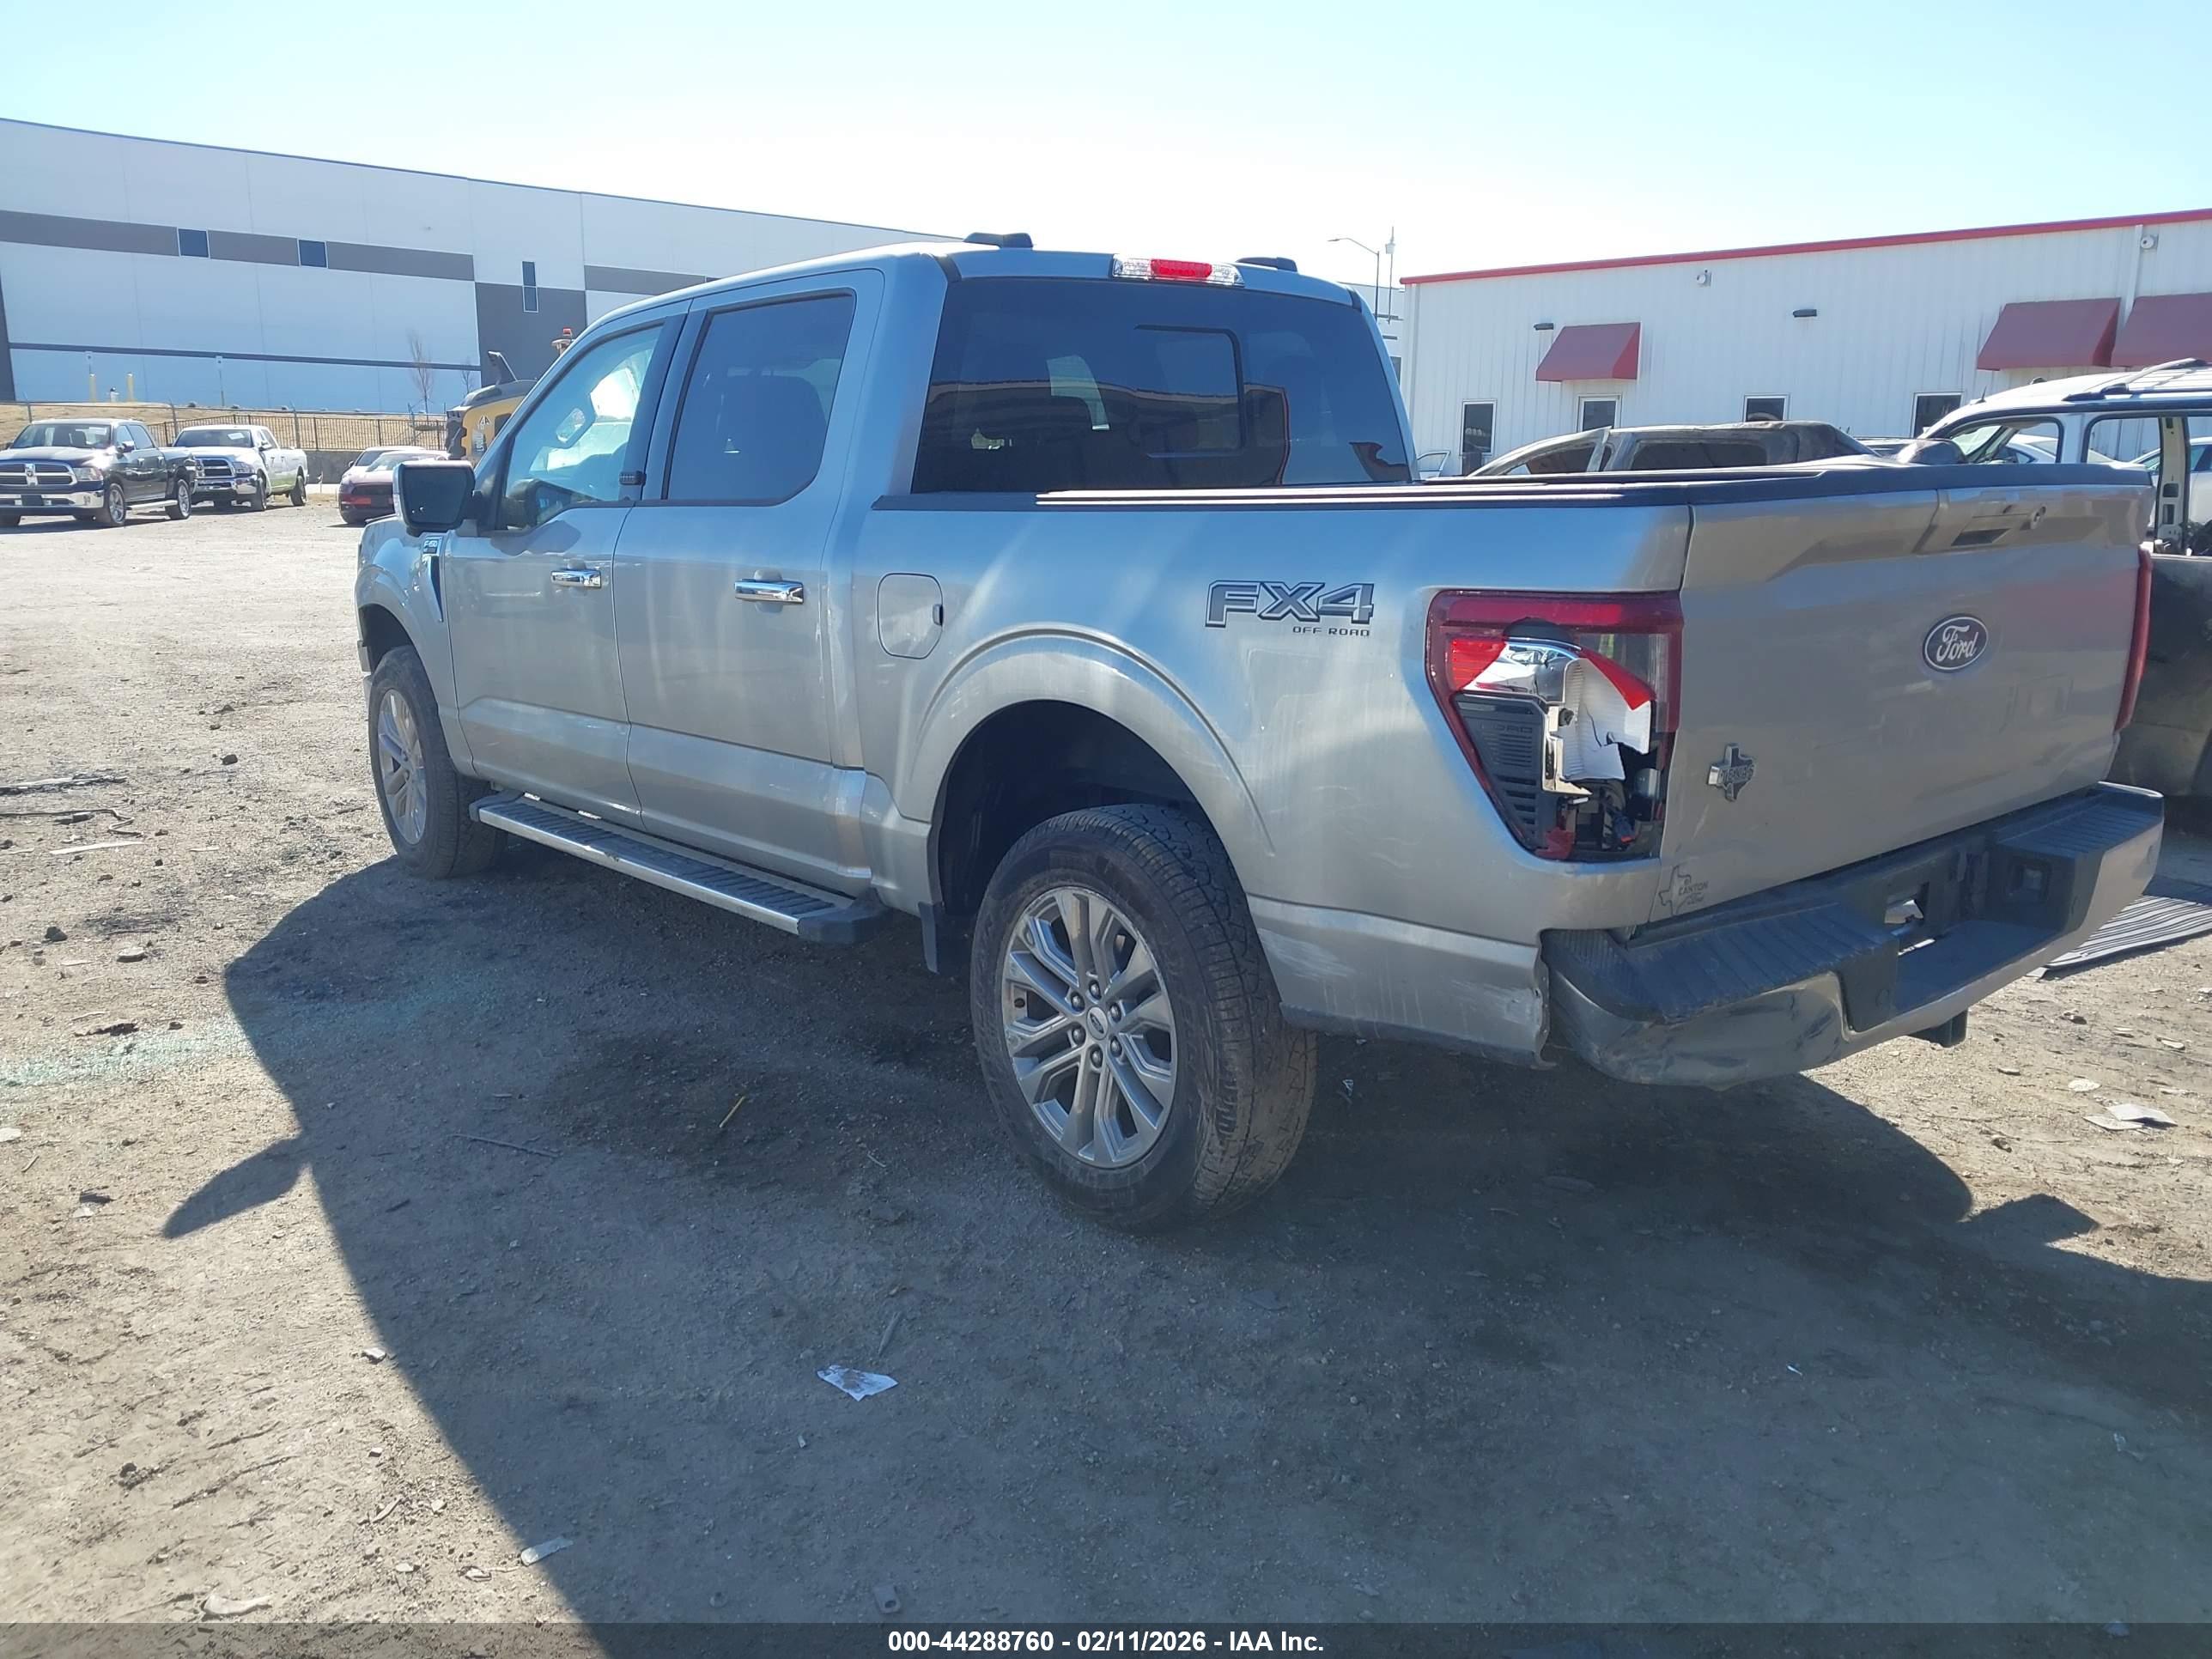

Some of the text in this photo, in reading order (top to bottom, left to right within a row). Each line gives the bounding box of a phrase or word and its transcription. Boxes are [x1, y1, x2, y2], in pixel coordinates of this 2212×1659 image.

[1206, 580, 1374, 628] FX4
[1293, 626, 1370, 636] OFF ROAD
[1936, 625, 1978, 662] Ford
